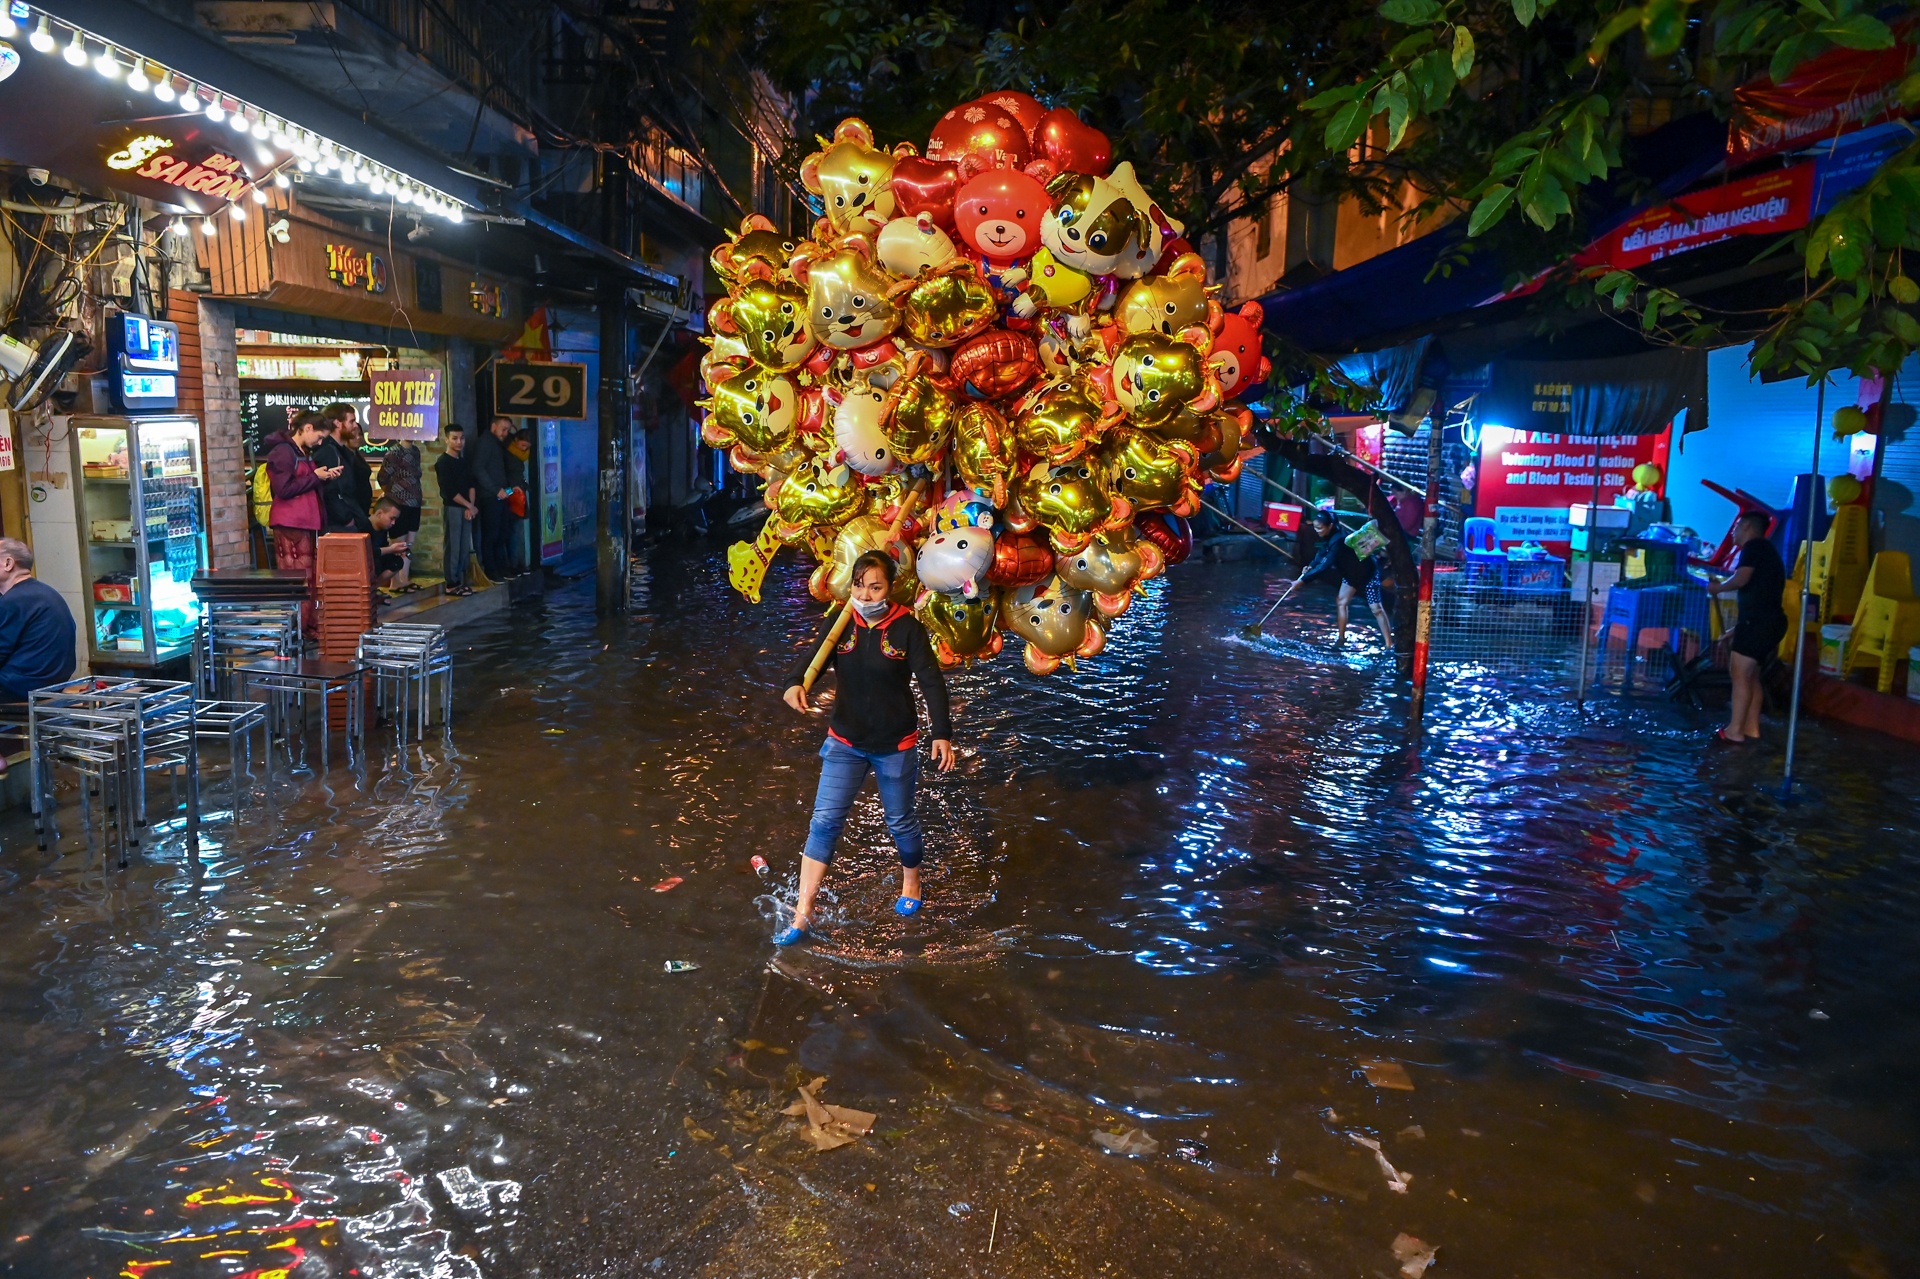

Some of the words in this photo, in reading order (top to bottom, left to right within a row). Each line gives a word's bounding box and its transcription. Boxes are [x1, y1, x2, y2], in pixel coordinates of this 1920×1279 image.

[202, 153, 241, 174] BIA
[136, 155, 251, 201] SAIGON
[374, 380, 402, 406] SIM
[404, 372, 436, 406] THẺ
[509, 374, 572, 407] 29
[379, 408, 399, 427] CÁC
[401, 412, 424, 433] LOẠI
[1501, 451, 1552, 468] Voluntary
[1553, 453, 1585, 468] Blood
[1587, 454, 1635, 468] Dnation
[1506, 471, 1527, 485] and
[1529, 471, 1560, 485] Blood
[1603, 473, 1626, 487] Site
